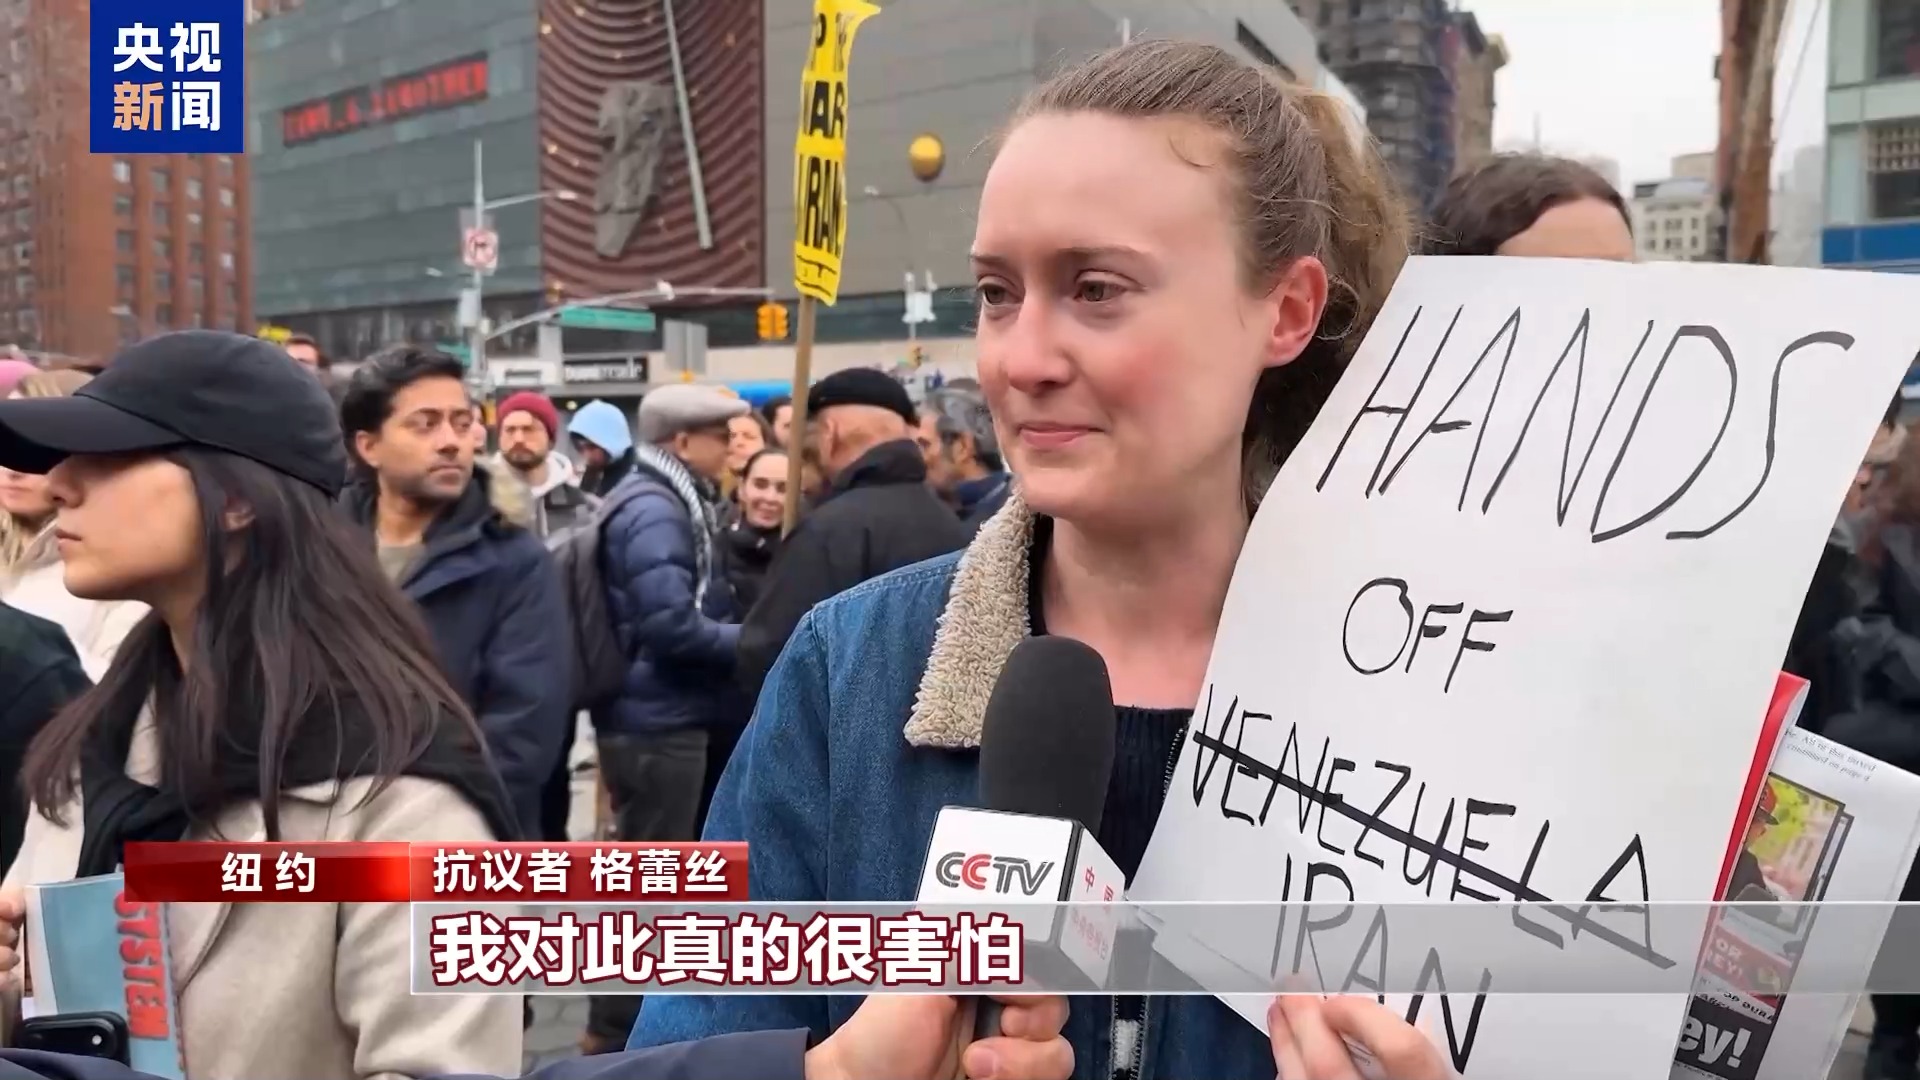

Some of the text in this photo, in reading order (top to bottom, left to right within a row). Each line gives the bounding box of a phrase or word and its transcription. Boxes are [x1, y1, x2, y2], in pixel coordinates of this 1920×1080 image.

[1316, 304, 1855, 543] HANDS
[1342, 577, 1514, 693] OFF
[936, 851, 1055, 896] CCTV
[1193, 684, 1655, 953] VENEZUELA
[1270, 853, 1492, 1074] IRAN
